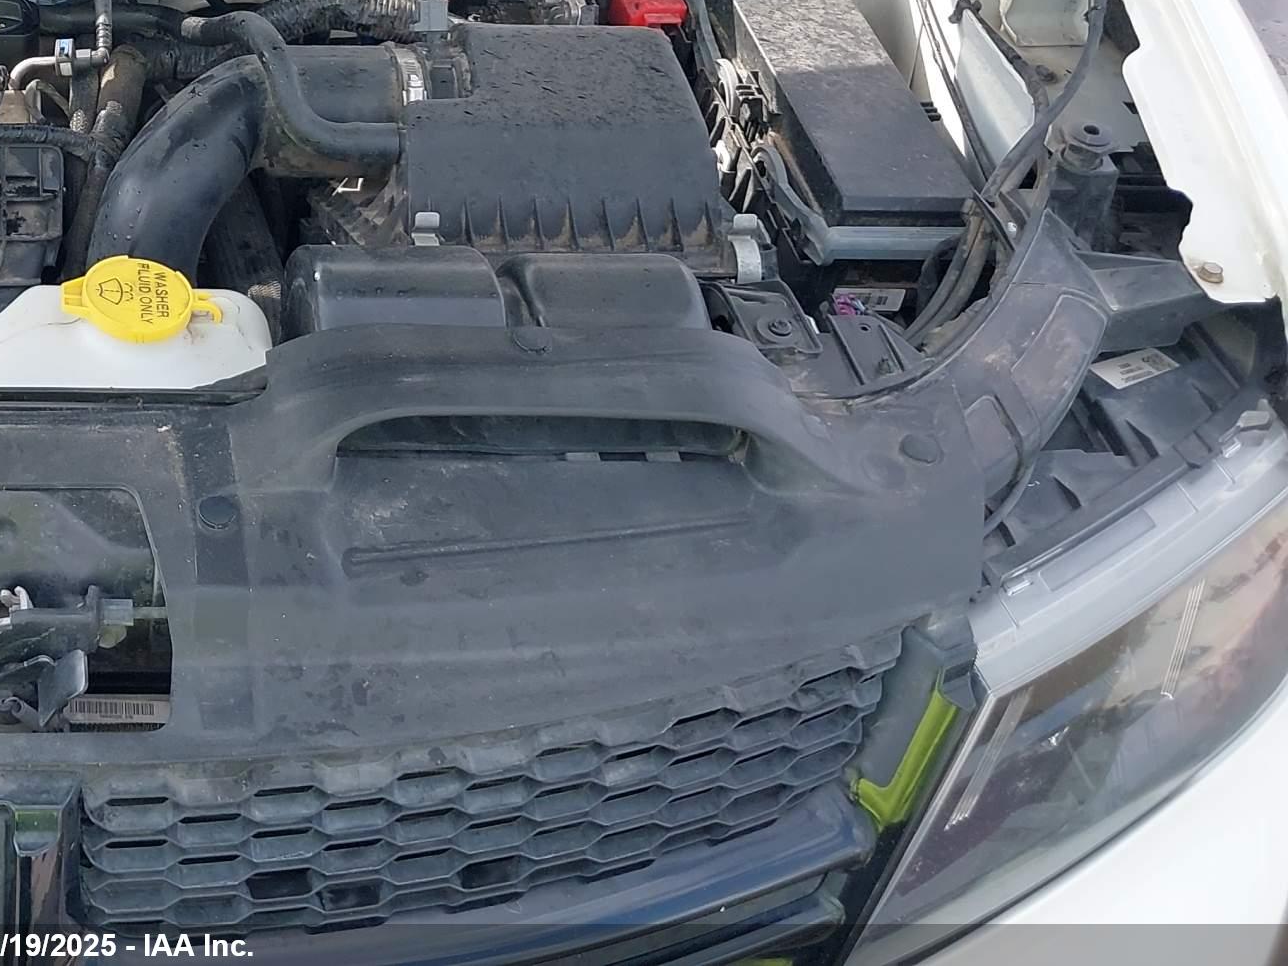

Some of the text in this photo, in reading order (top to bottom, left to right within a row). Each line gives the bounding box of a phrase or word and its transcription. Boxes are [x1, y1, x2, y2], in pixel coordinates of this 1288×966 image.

[137, 263, 154, 325] FLUID ONLY
[154, 271, 170, 318] WASHER
